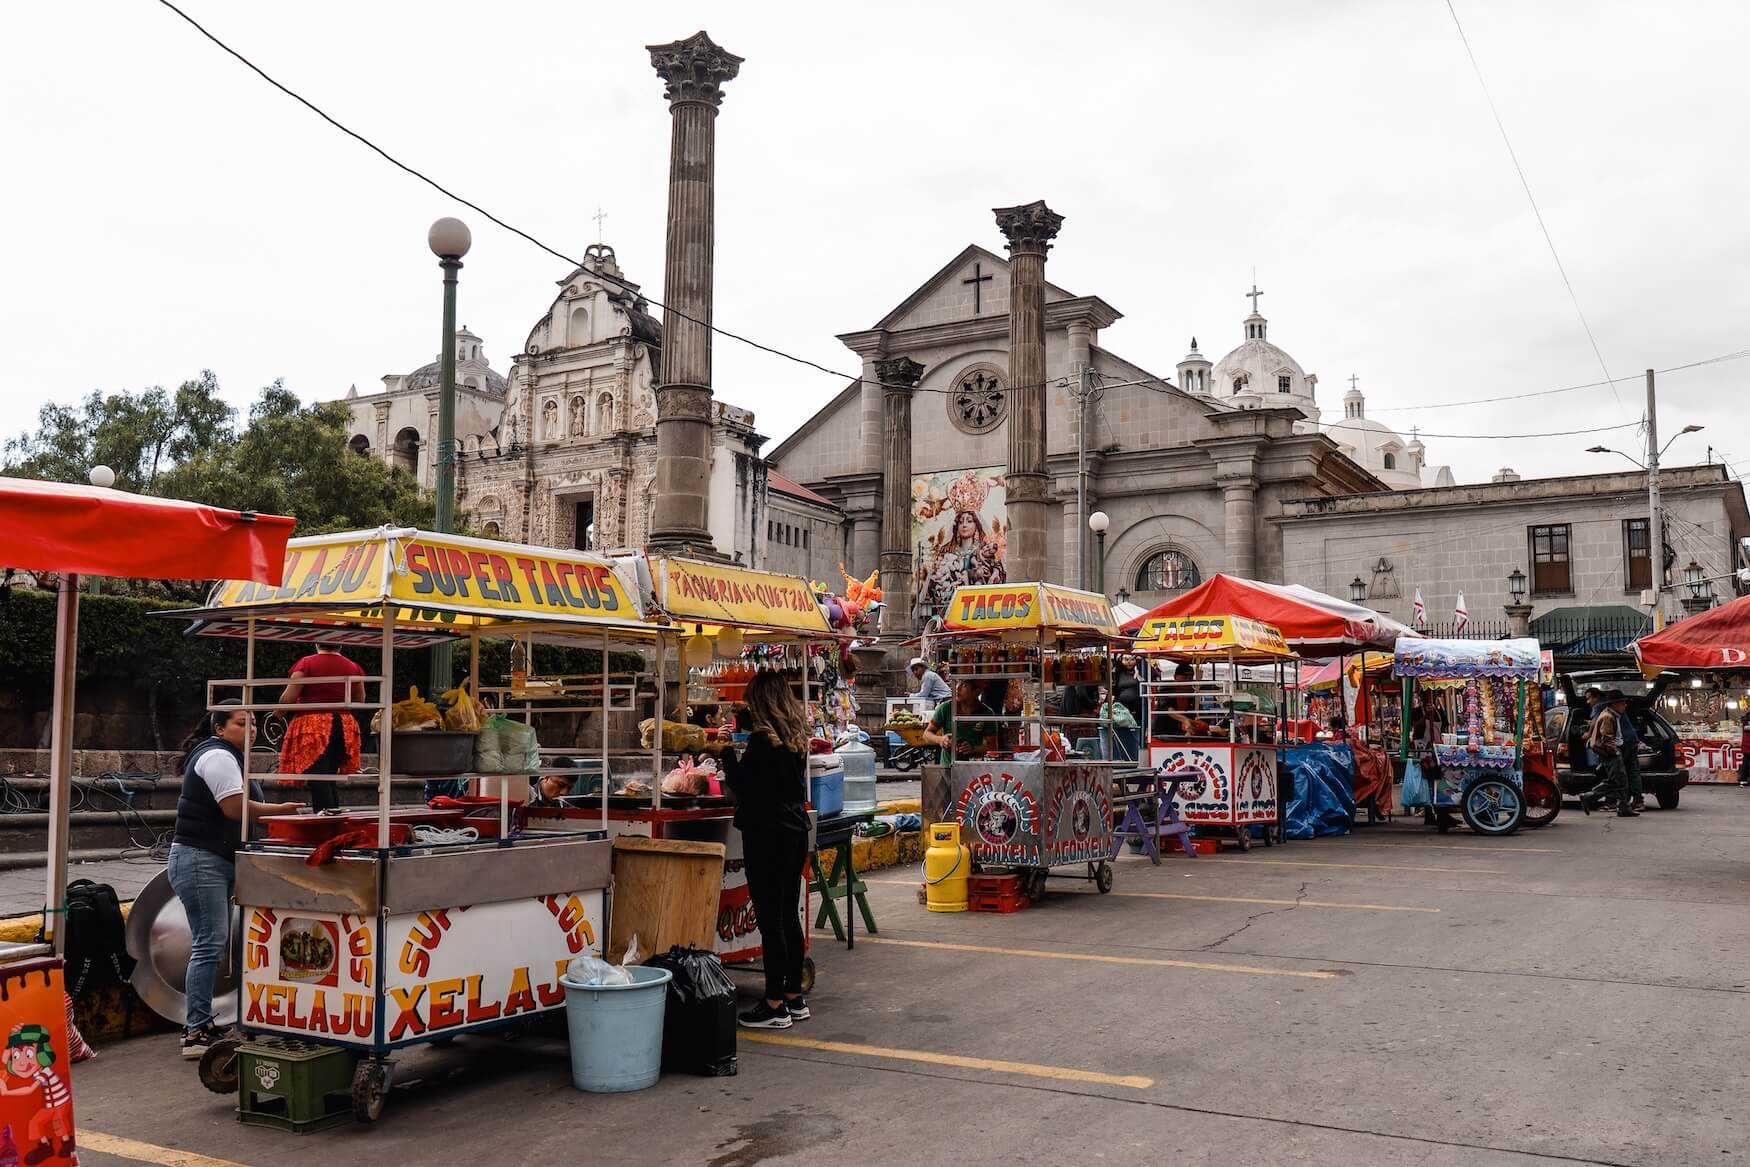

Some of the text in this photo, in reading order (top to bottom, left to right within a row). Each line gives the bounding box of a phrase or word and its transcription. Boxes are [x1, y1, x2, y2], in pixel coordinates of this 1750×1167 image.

[405, 544, 619, 611] SUPER TACOS
[670, 571, 743, 605] TAQUERIA
[961, 592, 1033, 621] TACOS
[1152, 619, 1225, 641] TACOS
[1191, 750, 1229, 802] TACOS
[956, 772, 994, 832] SUPER
[1001, 772, 1041, 836] TACOS
[246, 981, 375, 1038] XELAJU
